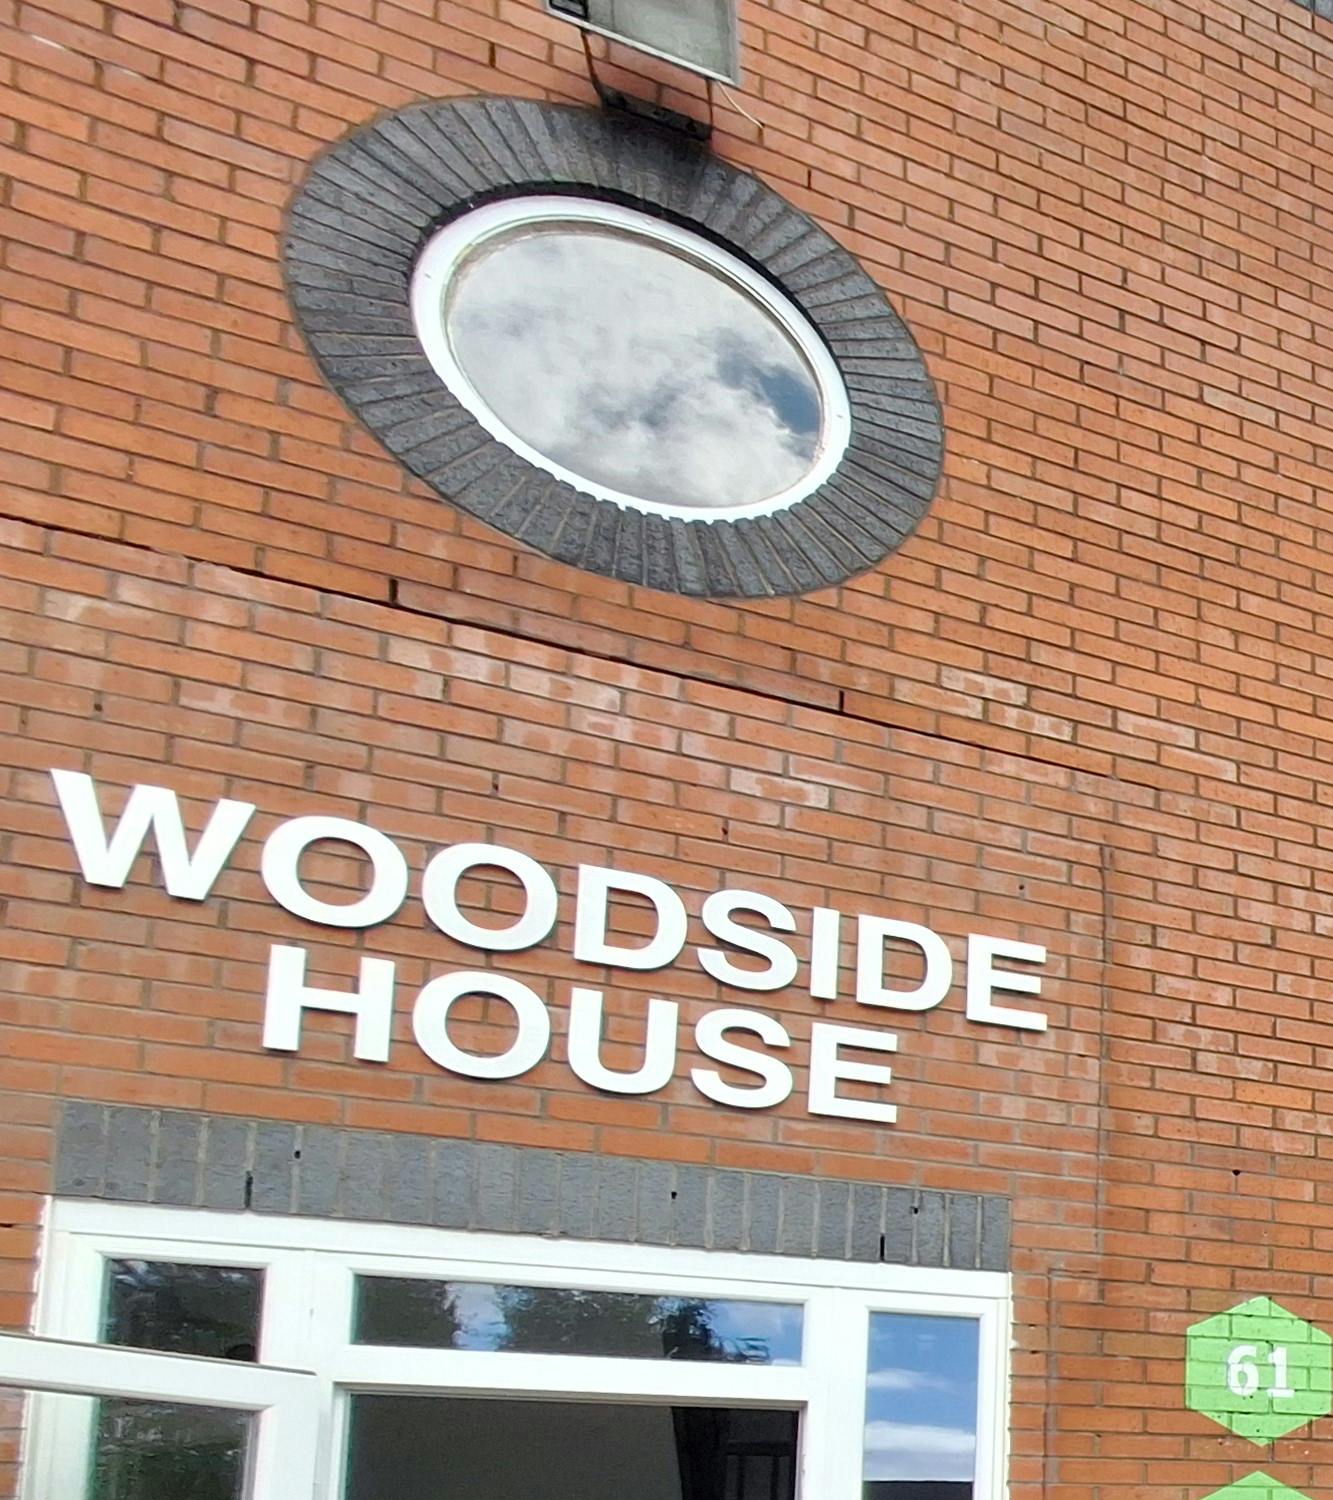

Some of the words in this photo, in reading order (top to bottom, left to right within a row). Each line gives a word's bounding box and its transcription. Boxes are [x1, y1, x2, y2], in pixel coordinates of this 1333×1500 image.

[50, 769, 1046, 1031] WOODSIDE
[263, 945, 897, 1123] HOUSE
[1226, 1345, 1295, 1398] 61
